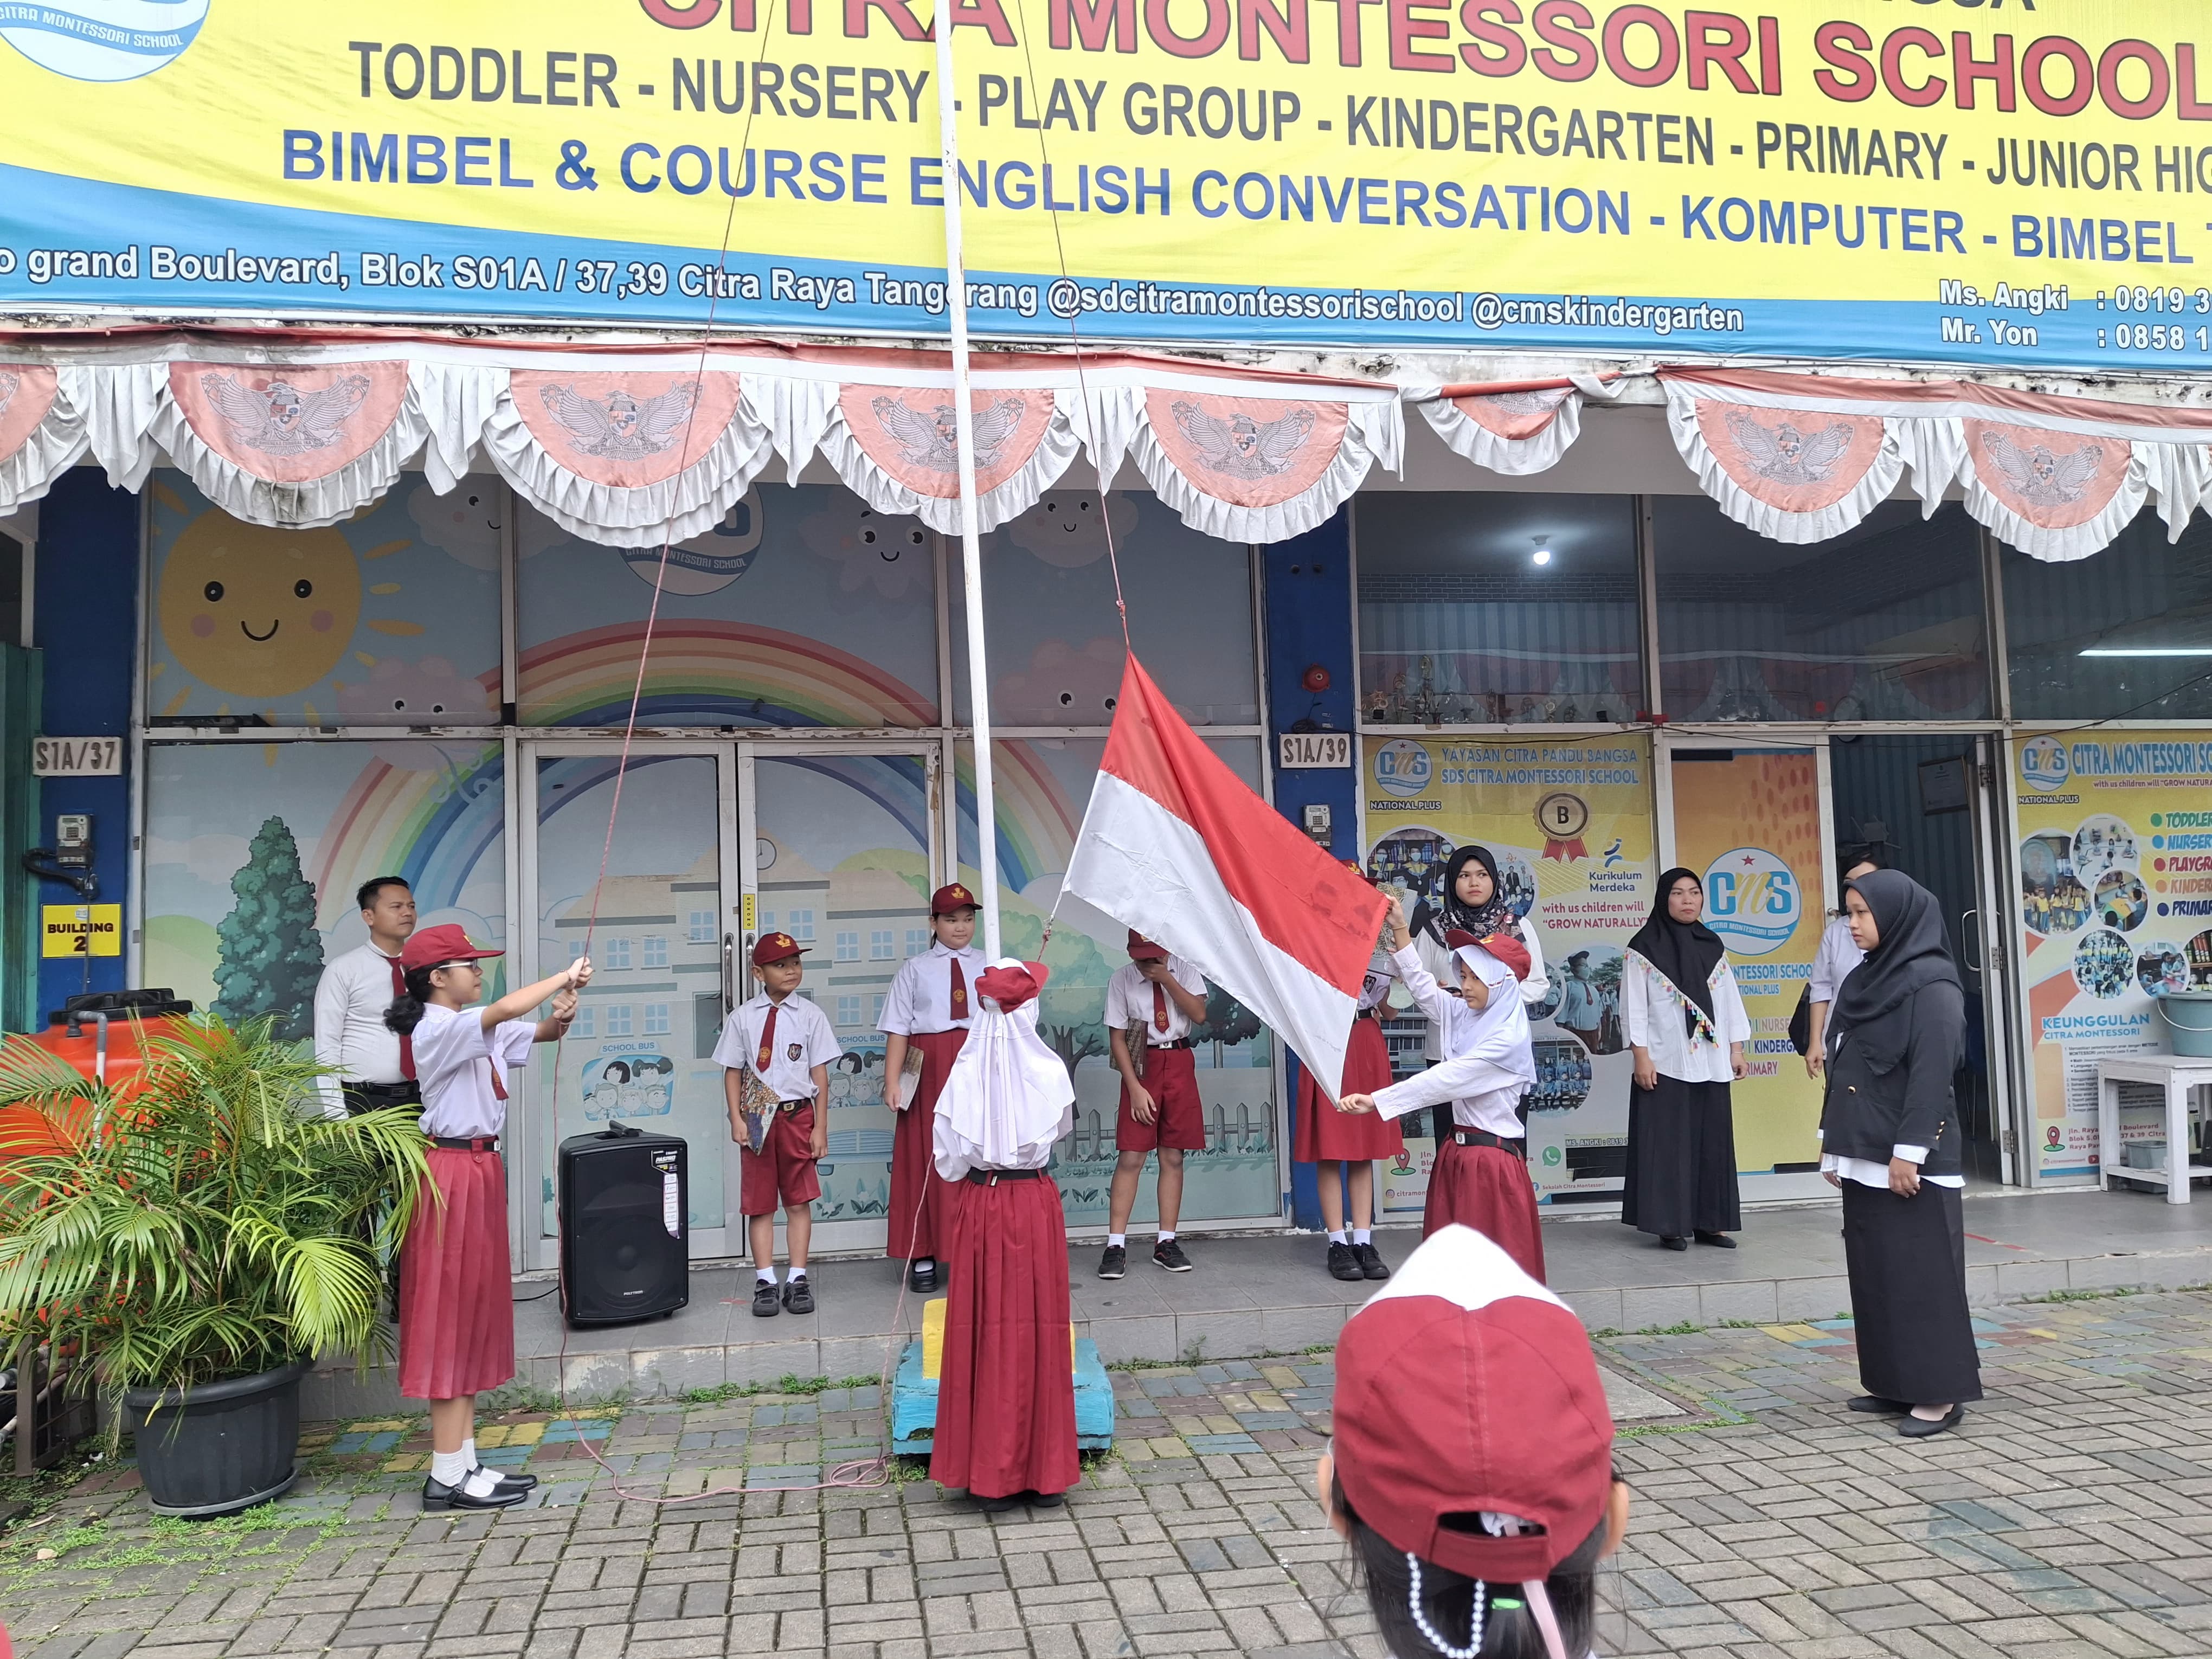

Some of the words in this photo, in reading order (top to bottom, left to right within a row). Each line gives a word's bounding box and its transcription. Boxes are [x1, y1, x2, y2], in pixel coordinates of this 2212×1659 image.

[43, 11, 130, 44] MONTESSORI
[133, 34, 184, 48] SCHOOL
[1048, 0, 1782, 97] MONTESSORI
[1813, 21, 2212, 121] SCHOOL
[349, 41, 620, 108] TODDLER
[673, 58, 930, 123] NURSERY
[979, 74, 1107, 132] PLAY
[1123, 82, 1301, 142] GROUP
[1348, 95, 1713, 166] KINDERGARTEN
[1757, 121, 1948, 181] PRIMARY
[1987, 138, 2142, 191] JUNIOR
[283, 130, 533, 187] BIMBEL
[555, 139, 599, 191] &
[621, 143, 888, 203] COURSE
[911, 157, 1171, 216] ENGLISH
[1193, 170, 1630, 235] CONVERSATION
[1682, 195, 1967, 254] KOMPUTER
[2012, 215, 2194, 263] BIMBEL
[28, 246, 139, 283] grand
[150, 247, 350, 290] Boulevard,
[361, 253, 443, 288] Blok
[452, 256, 546, 291] S01A
[575, 260, 669, 299] 37,39
[678, 264, 760, 300] Citra
[771, 268, 855, 310] Raya
[864, 272, 1038, 318] Tangrang
[1047, 279, 1463, 324] @sdcitramontessorischool
[1471, 292, 1744, 335] @cmskindergarten
[1939, 279, 1986, 307] Ms.
[1993, 282, 2068, 316] Angki
[2114, 287, 2185, 313] 0819
[1940, 317, 1982, 345] Mr.
[1988, 319, 2038, 347] Yon
[2115, 324, 2185, 350] 0858
[655, 547, 712, 568] MNTESSORI
[713, 560, 747, 569] SCHOOL
[37, 742, 115, 770] S1A/37
[1284, 738, 1347, 763] S1A/39
[1442, 748, 1500, 762] YAYASAN
[1504, 748, 1539, 762] CITRA
[1542, 748, 1583, 762] PANDU
[1587, 748, 1637, 762] BANGSA
[2072, 743, 2112, 775] CITRA
[2114, 743, 2196, 775] MONTESSORI
[1442, 769, 1464, 784] SDS
[1467, 769, 1506, 784] CITRA
[1506, 769, 1586, 784] MONTESSORI
[1589, 769, 1638, 784] SCHOOL
[2119, 780, 2145, 788] children
[2147, 779, 2159, 787] will
[1369, 801, 1418, 810] NATIONAL
[1418, 801, 1442, 810] PLUS
[2018, 796, 2059, 805] NATIONAL
[2059, 795, 2080, 804] PLUS
[1557, 806, 1569, 824] B
[1590, 871, 1642, 880] Kurikulum
[1590, 883, 1635, 892] Merdeka
[1542, 902, 1565, 913] with
[1582, 902, 1623, 912] children
[1625, 901, 1644, 911] will
[48, 923, 114, 934] BUILDING
[1729, 923, 1766, 935] MONTESSORI
[1767, 928, 1789, 936] SCHOOL
[74, 935, 87, 952] 2
[1731, 964, 1778, 980] NTESSORI
[1764, 984, 1779, 994] PLUS
[2042, 1014, 2150, 1029] KEUNGGULAN
[2044, 1031, 2073, 1039] CITRA
[2075, 1028, 2140, 1038] MONTESSORI
[602, 1044, 636, 1052] SCHOOL
[1566, 1139, 1578, 1147] MS.
[1580, 1138, 1602, 1146] ANGKI
[1607, 1137, 1623, 1146] 0819
